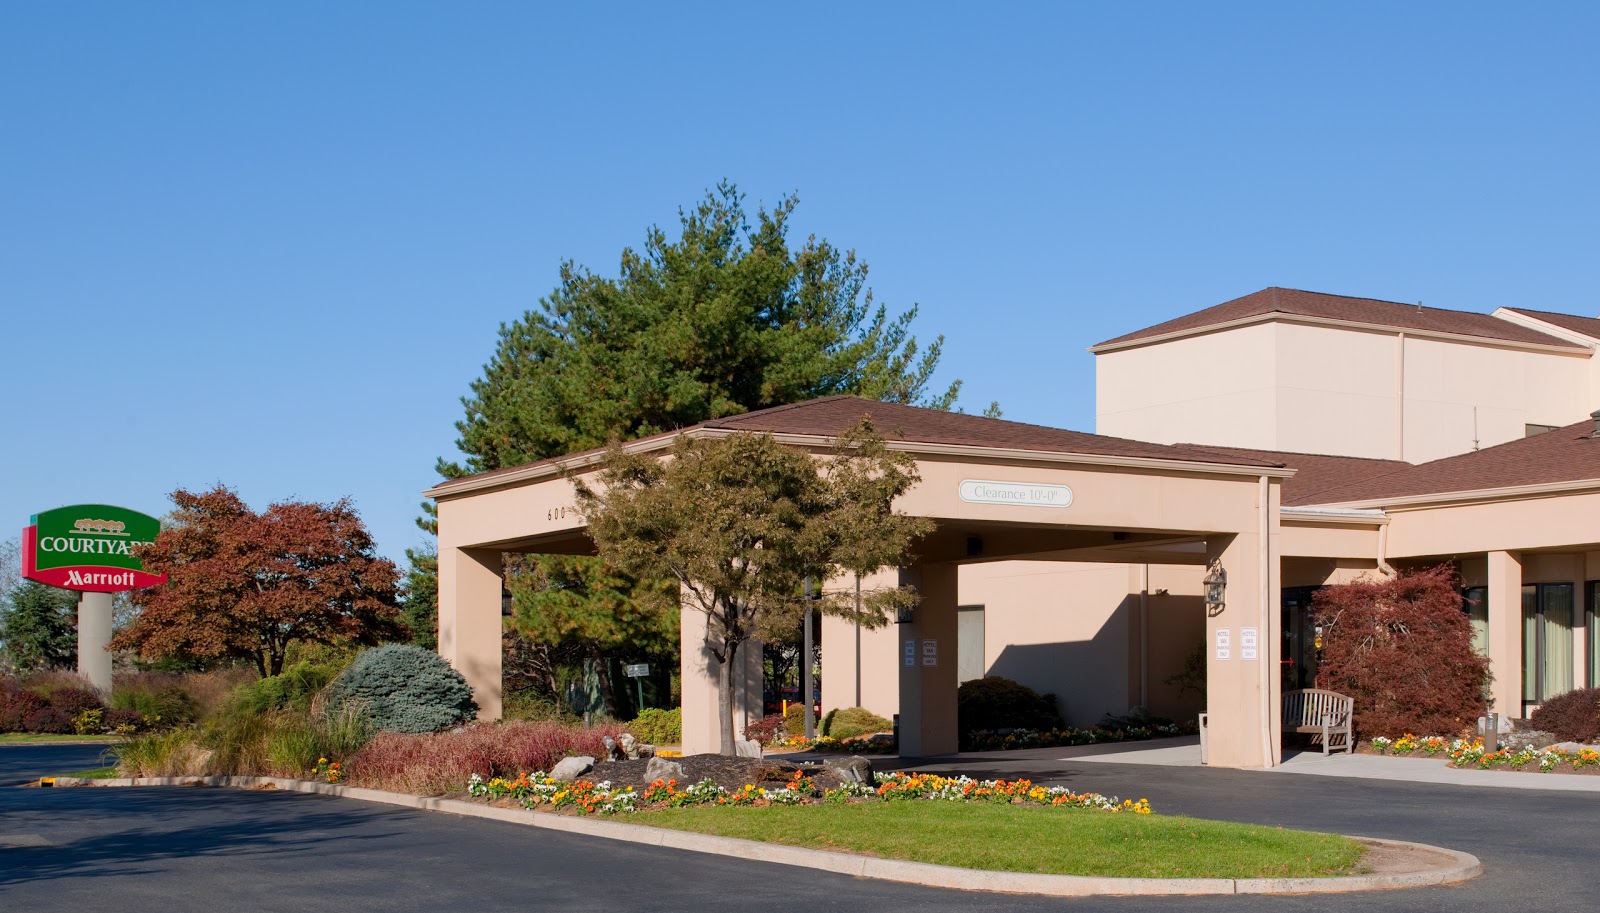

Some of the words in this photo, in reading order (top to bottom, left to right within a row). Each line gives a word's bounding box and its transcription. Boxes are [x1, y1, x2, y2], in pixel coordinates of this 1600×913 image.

[974, 485, 1026, 500] Clearance
[547, 506, 566, 521] 600
[63, 569, 135, 586] Marriott
